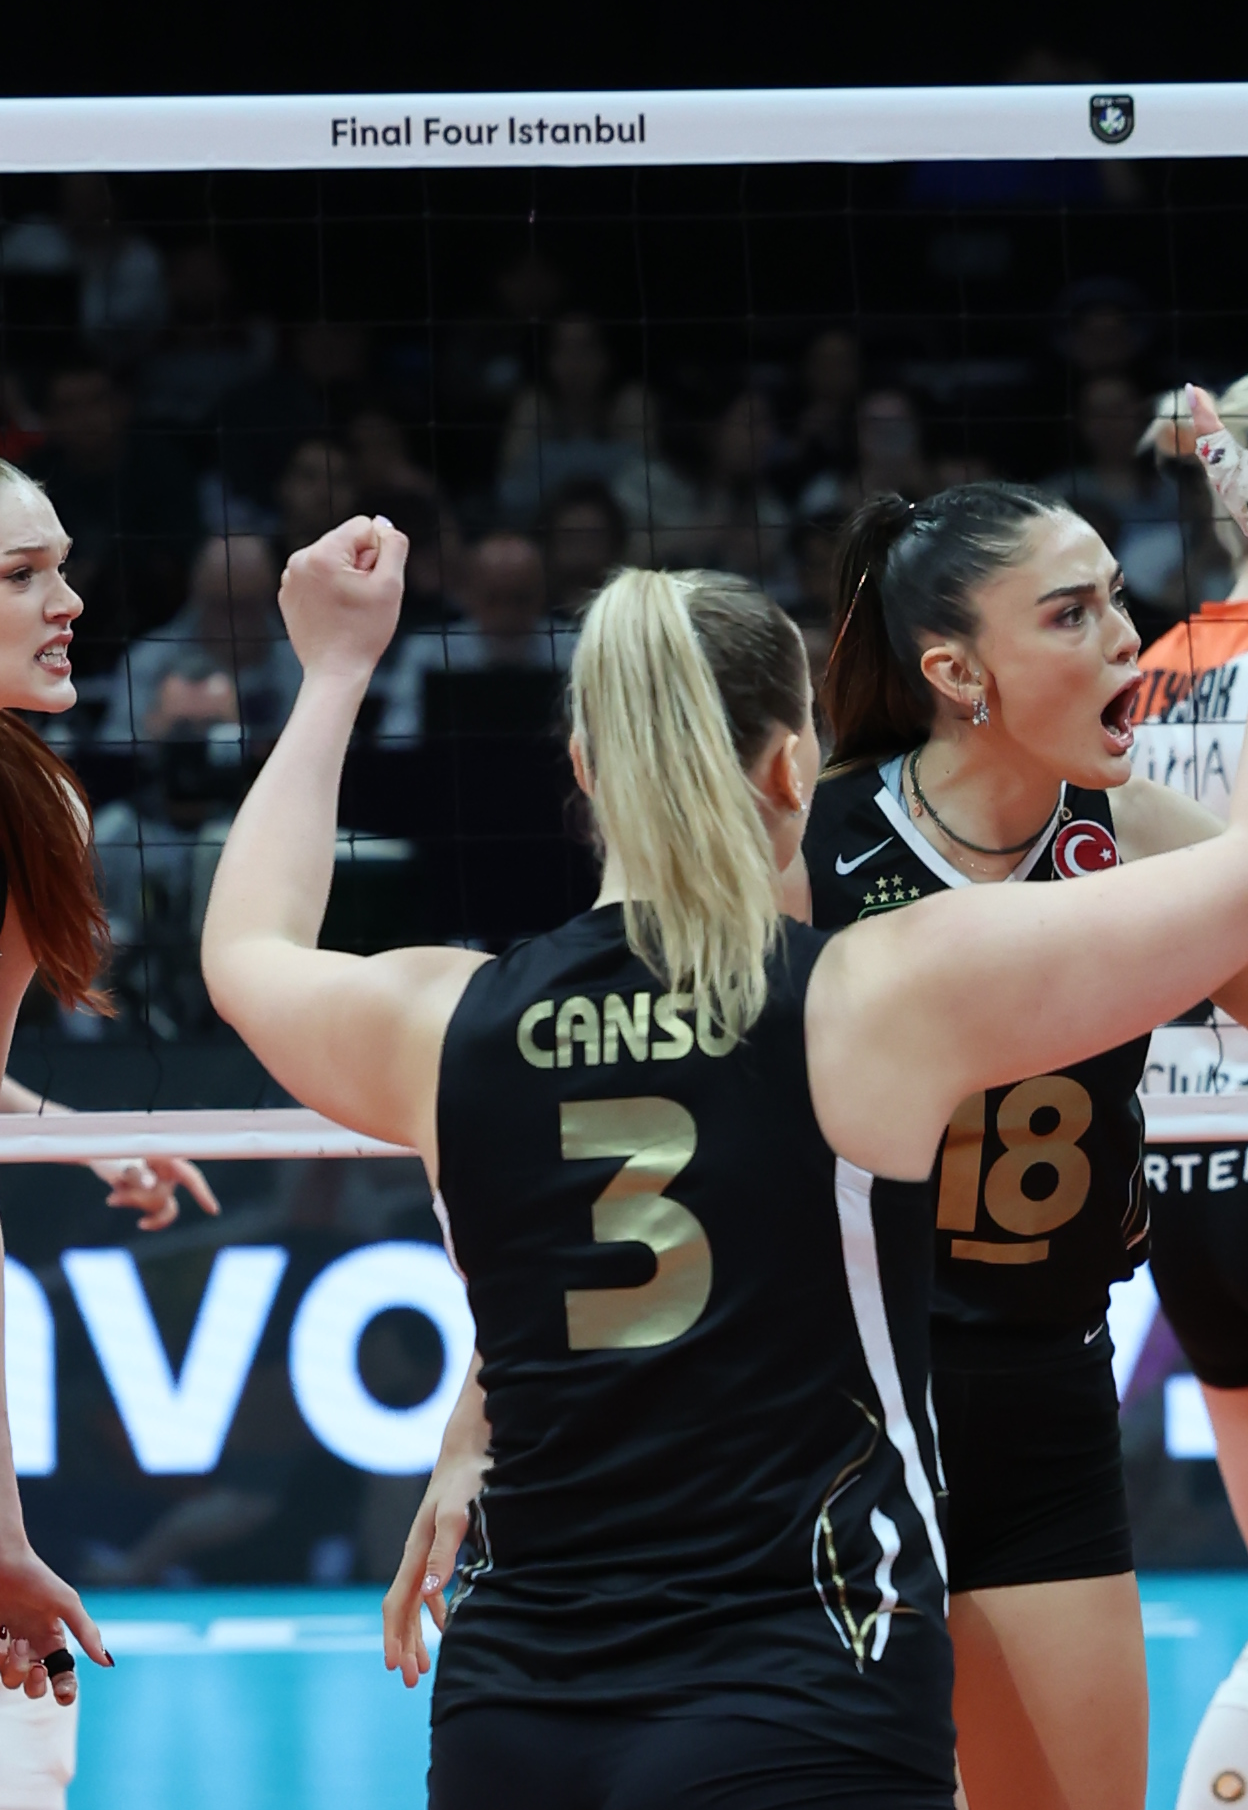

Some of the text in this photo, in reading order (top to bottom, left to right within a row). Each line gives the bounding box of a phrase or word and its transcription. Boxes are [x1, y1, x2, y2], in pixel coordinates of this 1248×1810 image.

[332, 113, 646, 146] Final Four Istanbul
[516, 992, 745, 1069] CANSU
[559, 1096, 713, 1351] 3
[935, 1074, 1093, 1237] 18
[4, 1239, 478, 1477] vo
